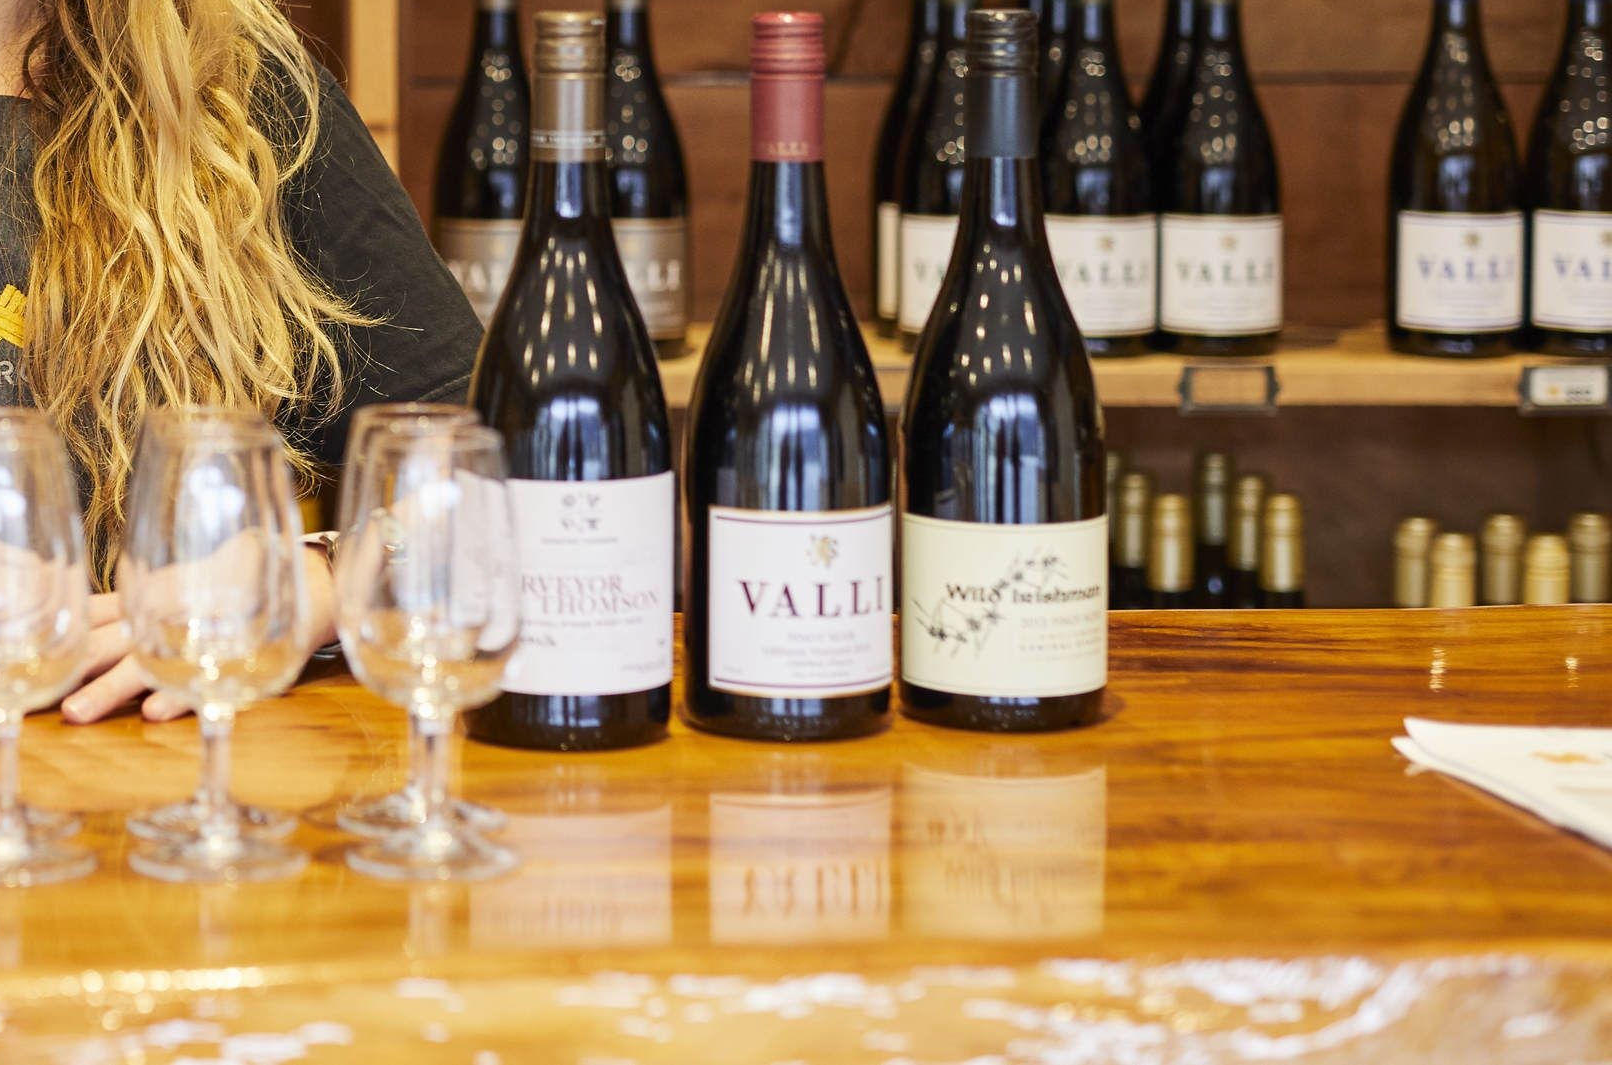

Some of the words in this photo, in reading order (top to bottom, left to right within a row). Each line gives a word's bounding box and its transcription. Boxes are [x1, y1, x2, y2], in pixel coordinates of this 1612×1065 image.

[1175, 257, 1276, 283] VALLI
[1417, 253, 1516, 280] VALLI
[520, 573, 624, 595] RVEYOR
[736, 574, 885, 619] VALLI
